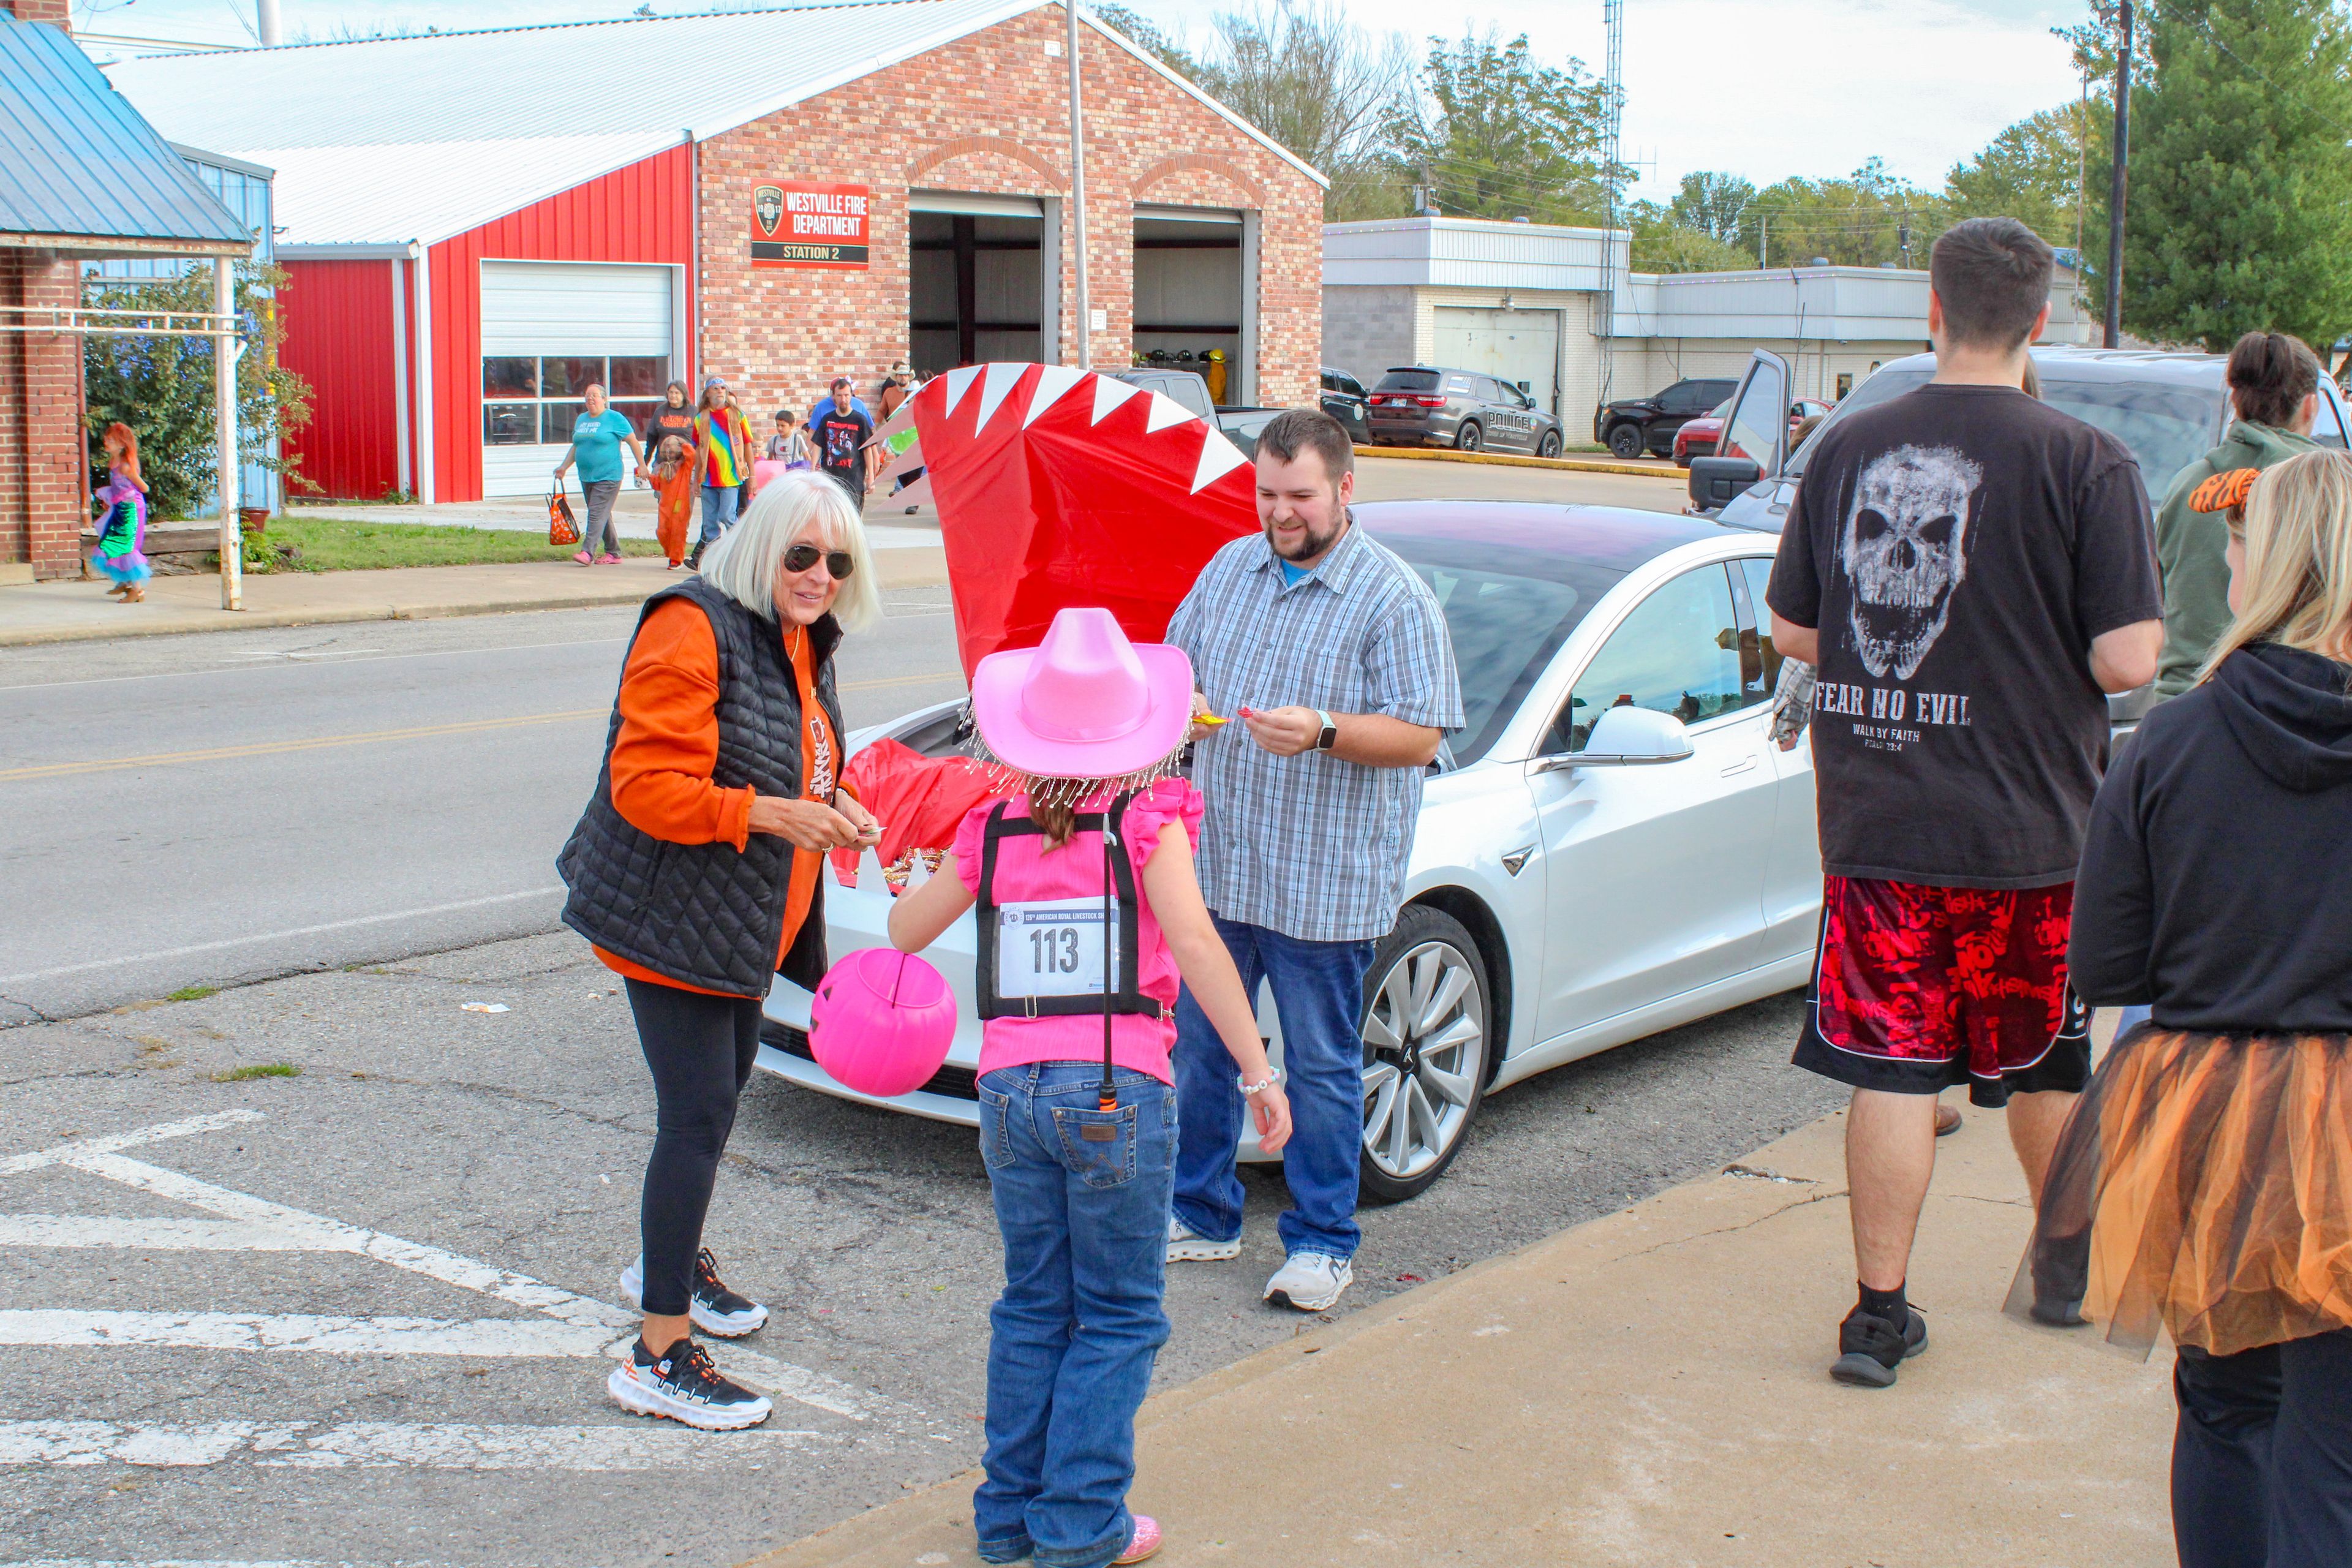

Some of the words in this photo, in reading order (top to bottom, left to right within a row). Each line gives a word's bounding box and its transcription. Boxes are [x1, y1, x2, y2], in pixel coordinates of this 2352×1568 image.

[758, 189, 780, 200] WESTVILLE
[786, 192, 843, 214] WESTVILLE
[845, 195, 867, 216] FIRE
[793, 214, 861, 236] DEPARTMENT
[784, 245, 829, 260] STATION
[832, 247, 839, 260] 2
[1487, 410, 1529, 434] POLICE
[1815, 682, 1864, 716] FEAR
[1871, 688, 1906, 721] NO
[1915, 692, 1970, 726] EVIL
[1852, 723, 1875, 737] WALK
[1877, 728, 1888, 739] BY
[1891, 729, 1921, 742] FAITH
[1030, 927, 1079, 973] 113
